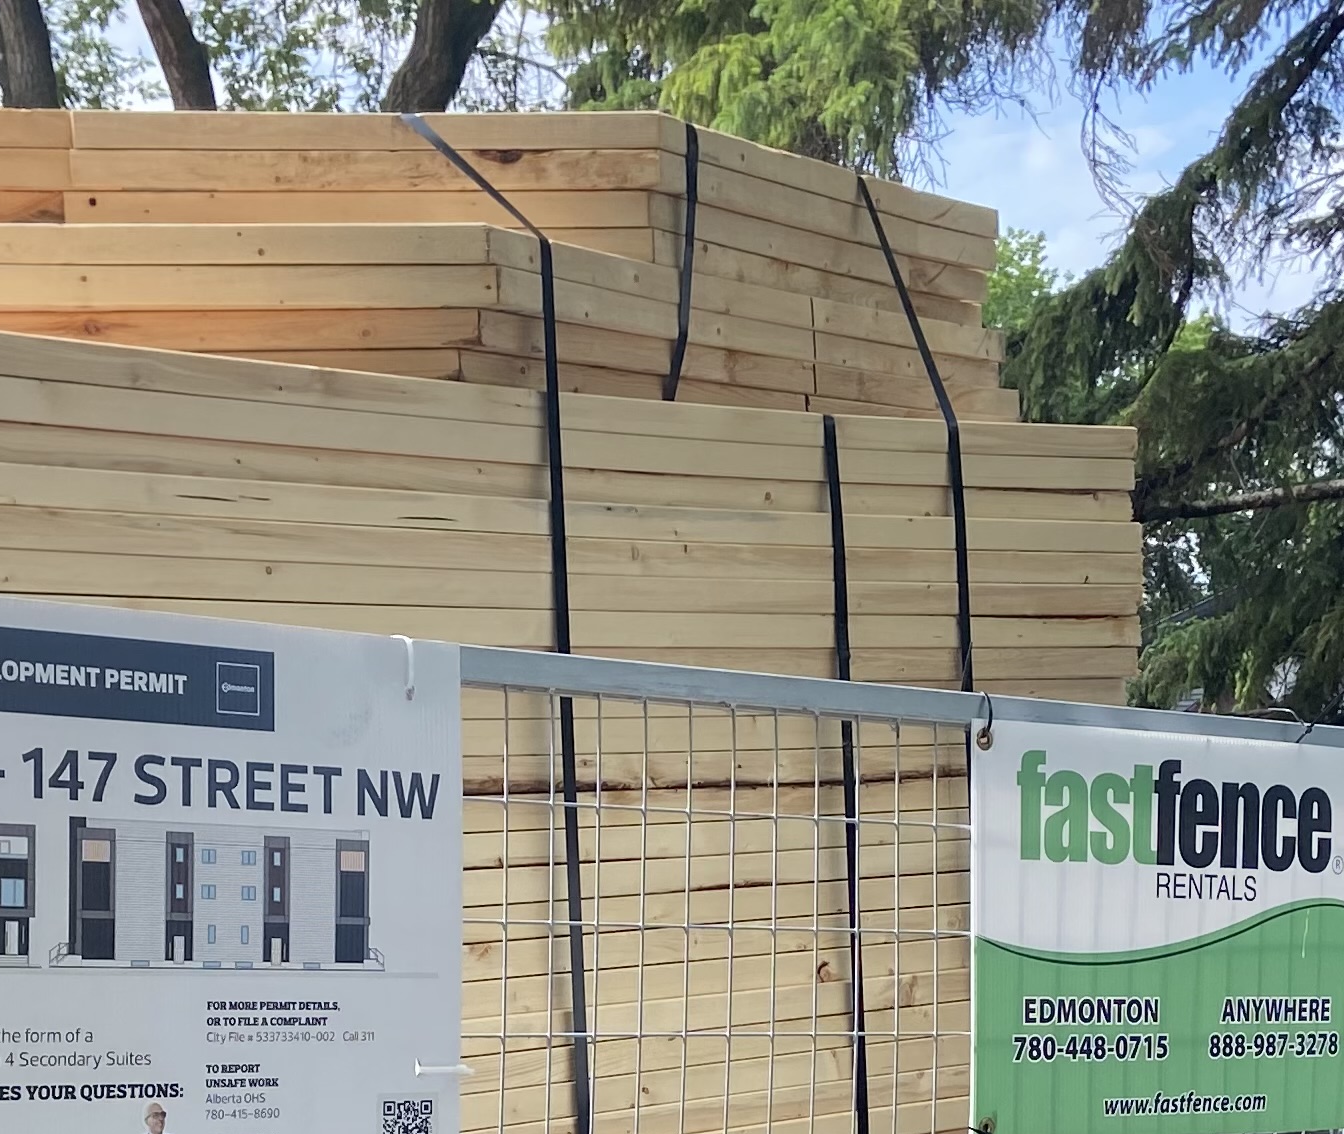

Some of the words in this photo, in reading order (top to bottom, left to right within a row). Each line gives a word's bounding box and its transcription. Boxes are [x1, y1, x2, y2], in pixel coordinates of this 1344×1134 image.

[105, 669, 188, 695] PERMIT
[21, 747, 118, 803] 147
[133, 754, 343, 815] STREET
[356, 768, 441, 820] NW
[1156, 872, 1257, 902] RENTALS
[206, 1001, 227, 1011] FOR
[229, 1001, 258, 1011] MORE
[259, 1001, 297, 1011] PERMIT
[1023, 997, 1160, 1025] EDMONTON
[1220, 998, 1332, 1024] ANYWHERE
[206, 1017, 221, 1026] OR
[223, 1017, 236, 1026] TO
[238, 1017, 259, 1026] FILE
[260, 1017, 269, 1026] A
[270, 1017, 328, 1026] COMPLAINT
[25, 1028, 62, 1043] form
[65, 1028, 81, 1043] of
[84, 1031, 94, 1043] a
[206, 1031, 226, 1044] City
[228, 1031, 245, 1042] File
[342, 1031, 359, 1042] Call
[360, 1031, 375, 1042] 311
[1012, 1034, 1169, 1063] 780-448-0715
[1208, 1032, 1339, 1059] 888-987-3278
[4, 1052, 15, 1067] 4
[19, 1051, 103, 1070] Secondary
[105, 1051, 152, 1066] Suites
[206, 1064, 219, 1074] TO
[221, 1063, 261, 1074] REPORT
[206, 1078, 246, 1088] UNSAFE
[248, 1077, 279, 1088] WORK
[25, 1085, 77, 1101] YOUR
[80, 1083, 184, 1102] QUESTIONS:
[205, 1093, 243, 1104] Alberta
[244, 1092, 266, 1103] OHS
[205, 1107, 280, 1120] 780-415-8690
[1103, 1091, 1267, 1117] www.fastfence.com
